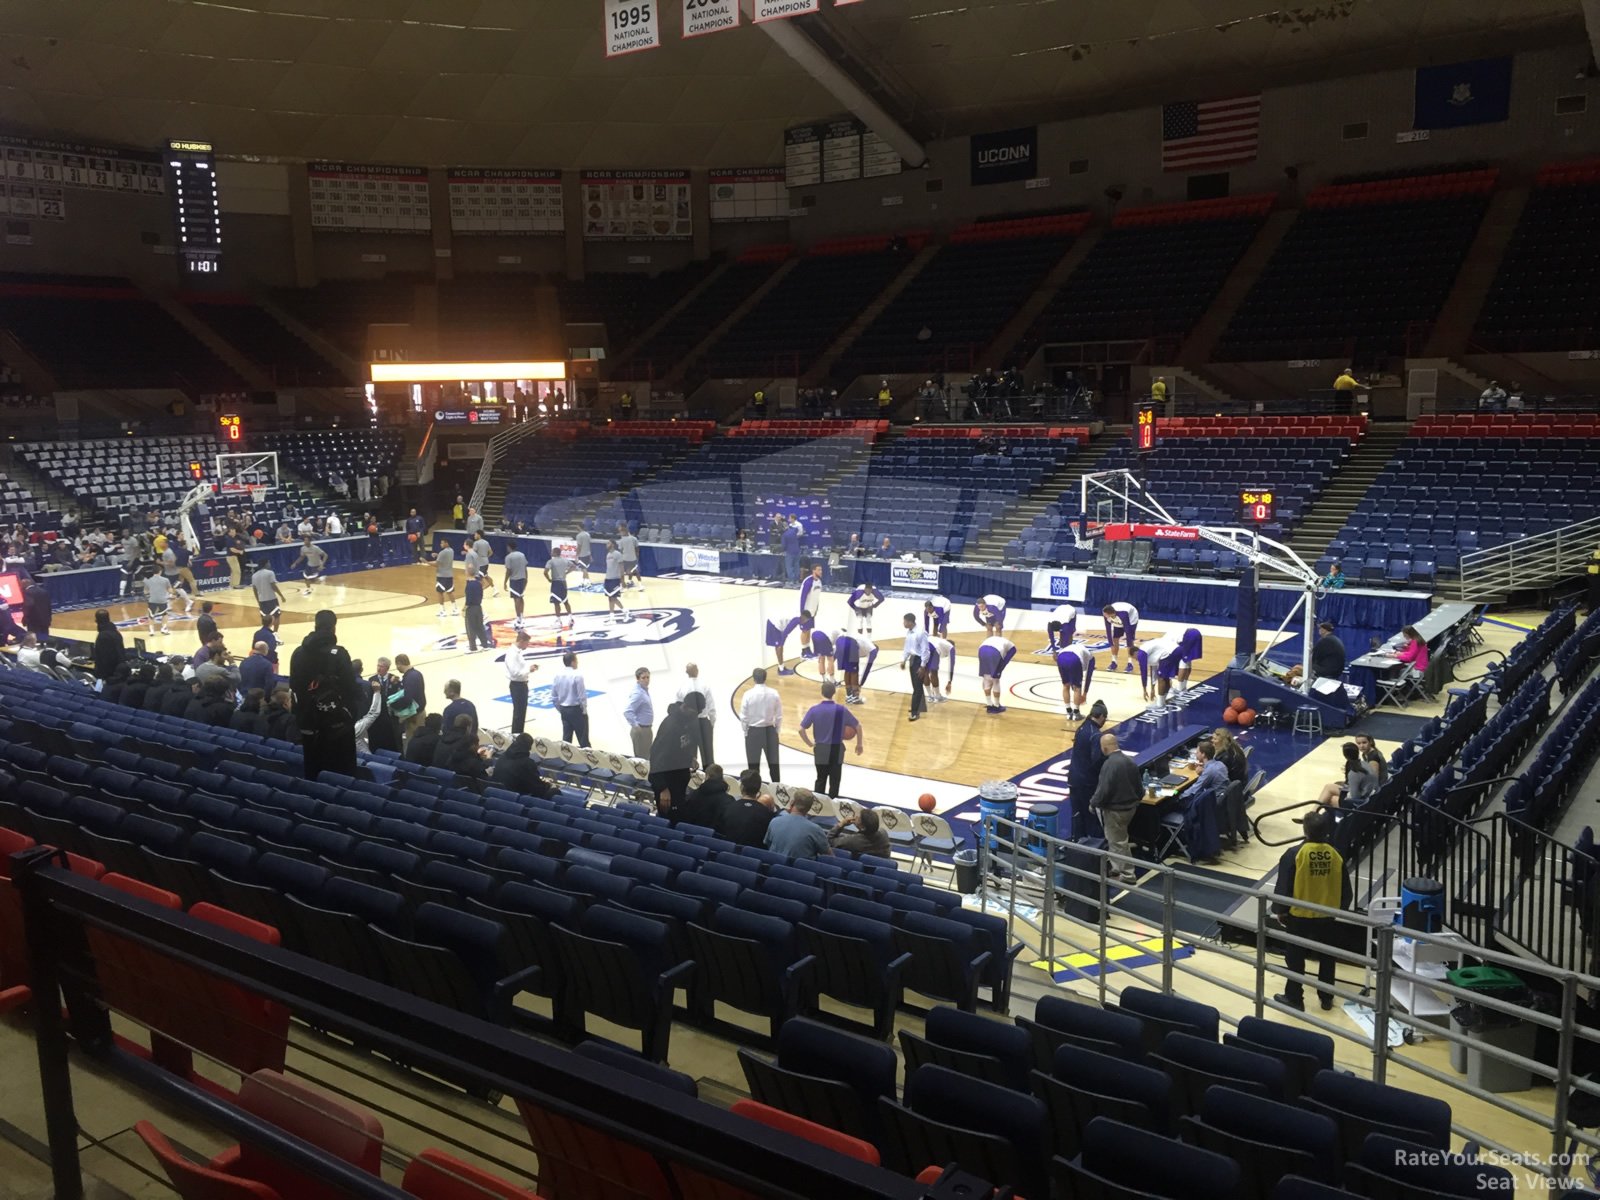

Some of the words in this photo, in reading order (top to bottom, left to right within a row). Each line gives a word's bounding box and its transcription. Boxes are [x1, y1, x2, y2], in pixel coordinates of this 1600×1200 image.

[691, 7, 730, 21] NATIONAL
[760, 1, 811, 17] CHAMPIONS
[612, 4, 650, 29] 1995
[689, 17, 733, 33] CHAMPIONS
[614, 27, 650, 41] NATIONAL
[612, 37, 653, 52] CHAMPIONS
[181, 143, 212, 151] HUSKIES
[978, 144, 1030, 164] UCONN
[346, 165, 422, 175] CHAMPIONSHIP
[454, 170, 480, 178] NCAA
[484, 170, 556, 178] CHAMPIONSHIP
[146, 177, 158, 189] 14
[44, 201, 60, 216] 23
[190, 261, 218, 272] 11:01
[230, 424, 239, 439] 0
[1144, 425, 1151, 448] 0
[1242, 493, 1272, 504] 56:18
[1256, 504, 1266, 519] 0
[893, 568, 909, 578] WTIC
[923, 570, 938, 580] 1080
[1308, 851, 1331, 861] CSC
[1309, 861, 1331, 870] EVENT
[1309, 869, 1331, 877] STAFF
